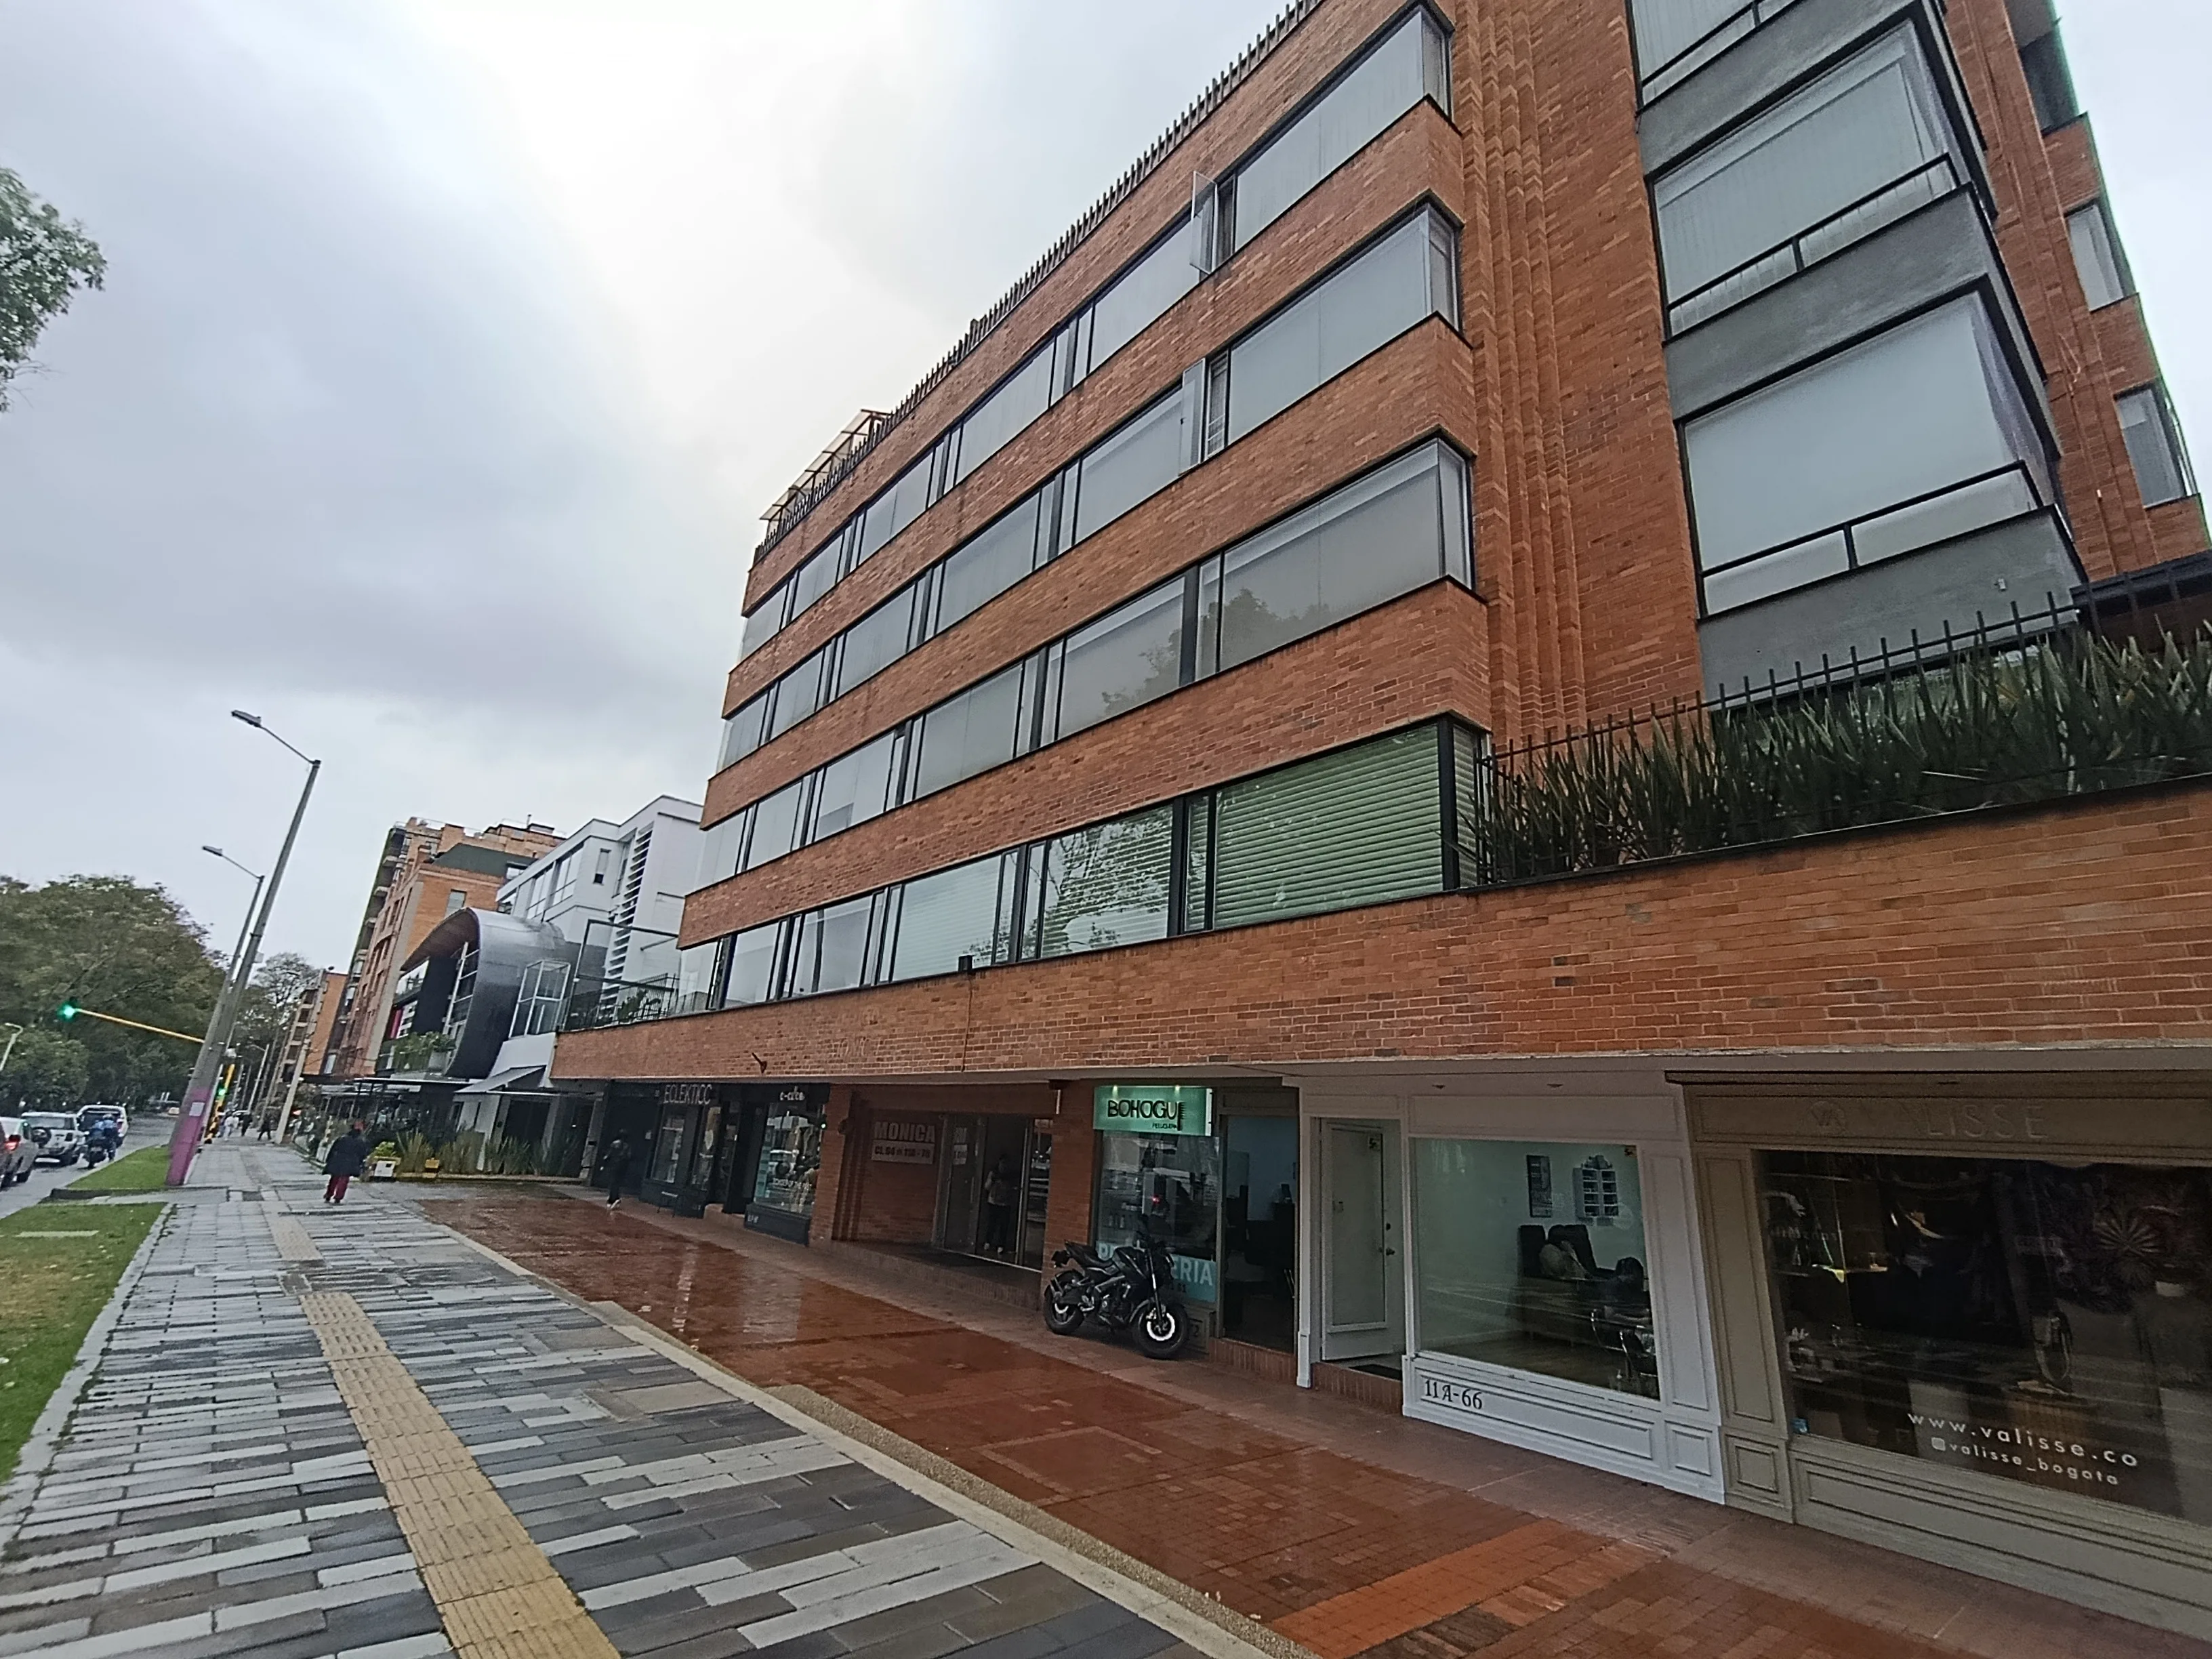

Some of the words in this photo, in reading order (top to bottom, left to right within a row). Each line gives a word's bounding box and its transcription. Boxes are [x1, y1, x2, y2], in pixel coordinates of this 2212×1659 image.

[874, 1121, 936, 1143] MONICA
[1425, 1379, 1483, 1410] 11A-66
[1907, 1412, 2139, 1467] www.valisse.co
[1948, 1443, 2118, 1486] valisse_bogota
